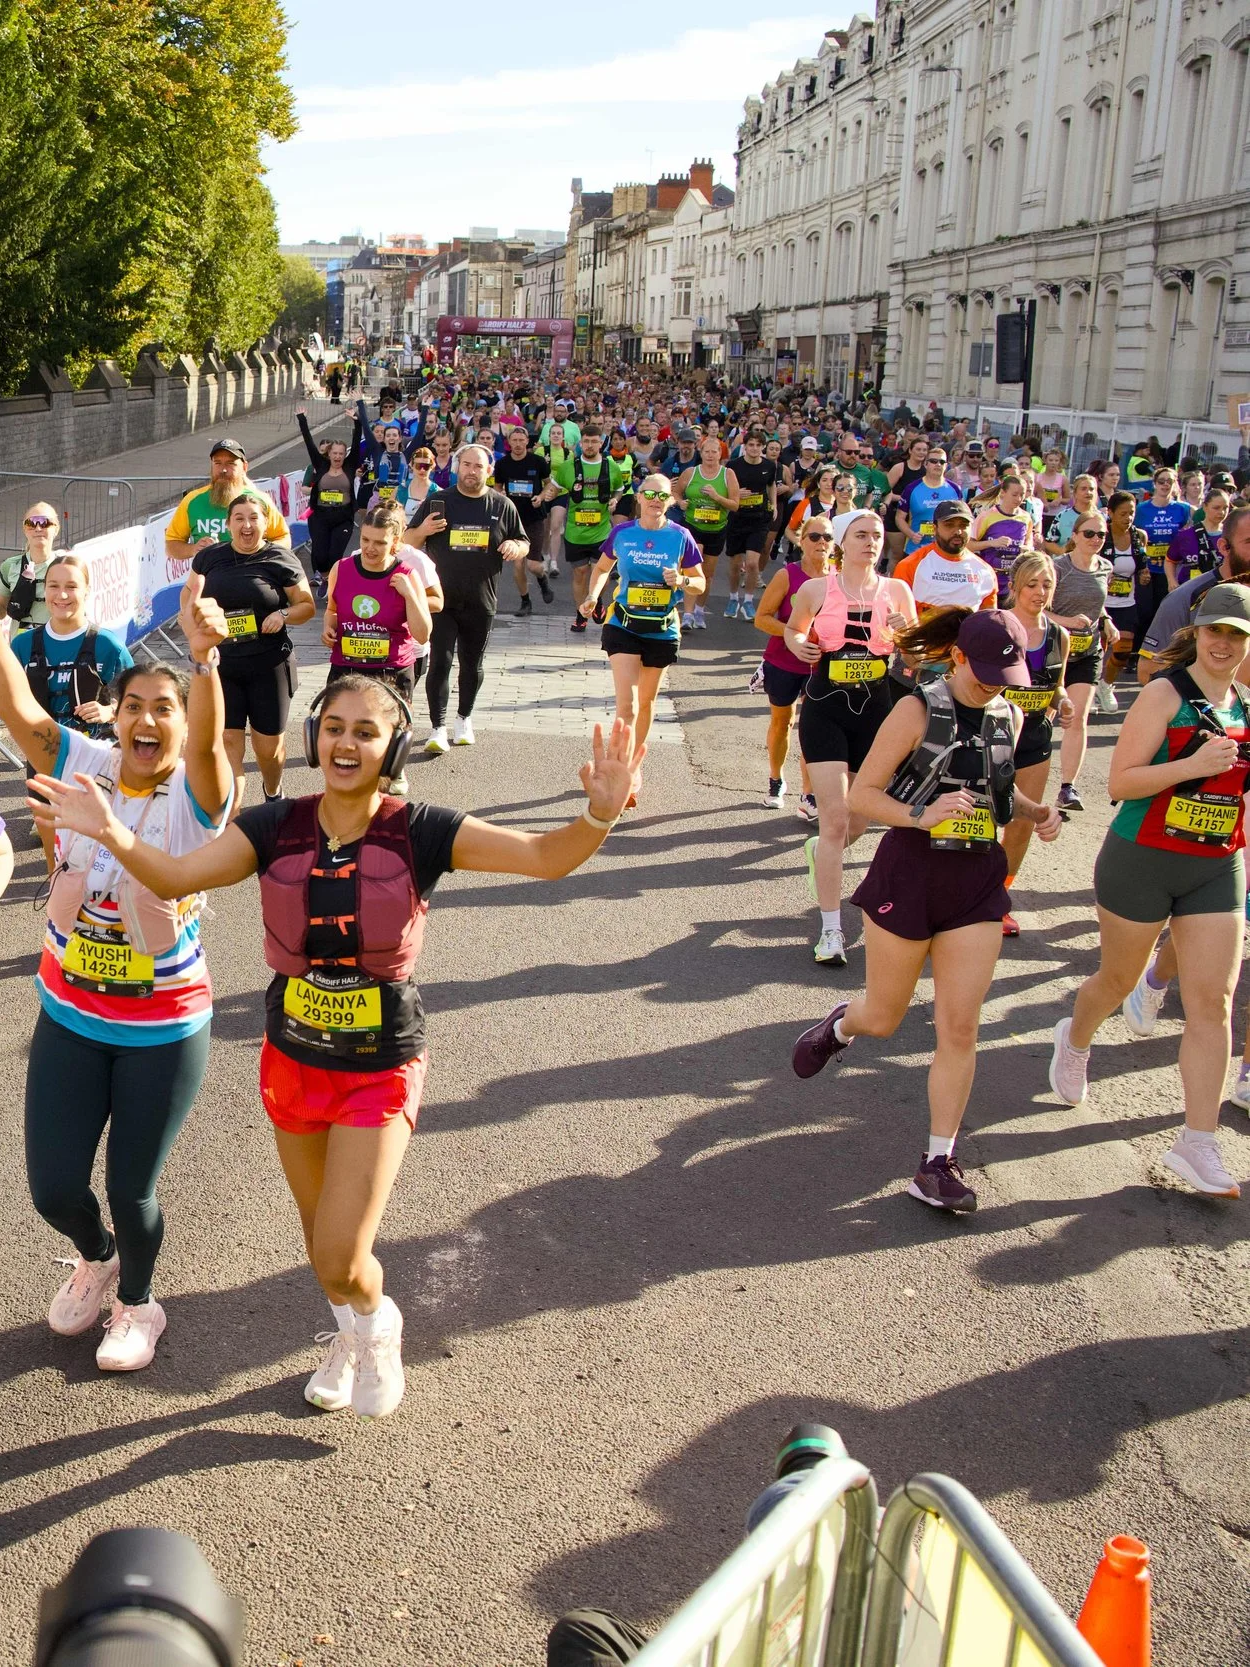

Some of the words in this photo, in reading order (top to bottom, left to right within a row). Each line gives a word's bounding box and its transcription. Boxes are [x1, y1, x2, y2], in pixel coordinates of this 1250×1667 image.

[627, 550, 668, 560] Alzheimer's
[633, 557, 661, 568] Society
[349, 639, 380, 647] BETHAN
[353, 647, 376, 655] 12207
[846, 662, 871, 670] POSY
[844, 671, 873, 679] 12873
[1008, 692, 1029, 700] LAURA
[1175, 801, 1236, 819] STEPHANIE
[952, 822, 984, 835] 25756
[1189, 816, 1225, 831] 14157
[78, 942, 132, 962] AYUSHI
[81, 958, 128, 978] 14254
[315, 974, 340, 986] CARDIFF
[341, 976, 359, 985] HALF
[296, 983, 367, 1009] LAVANYA
[303, 1004, 354, 1026] 29399
